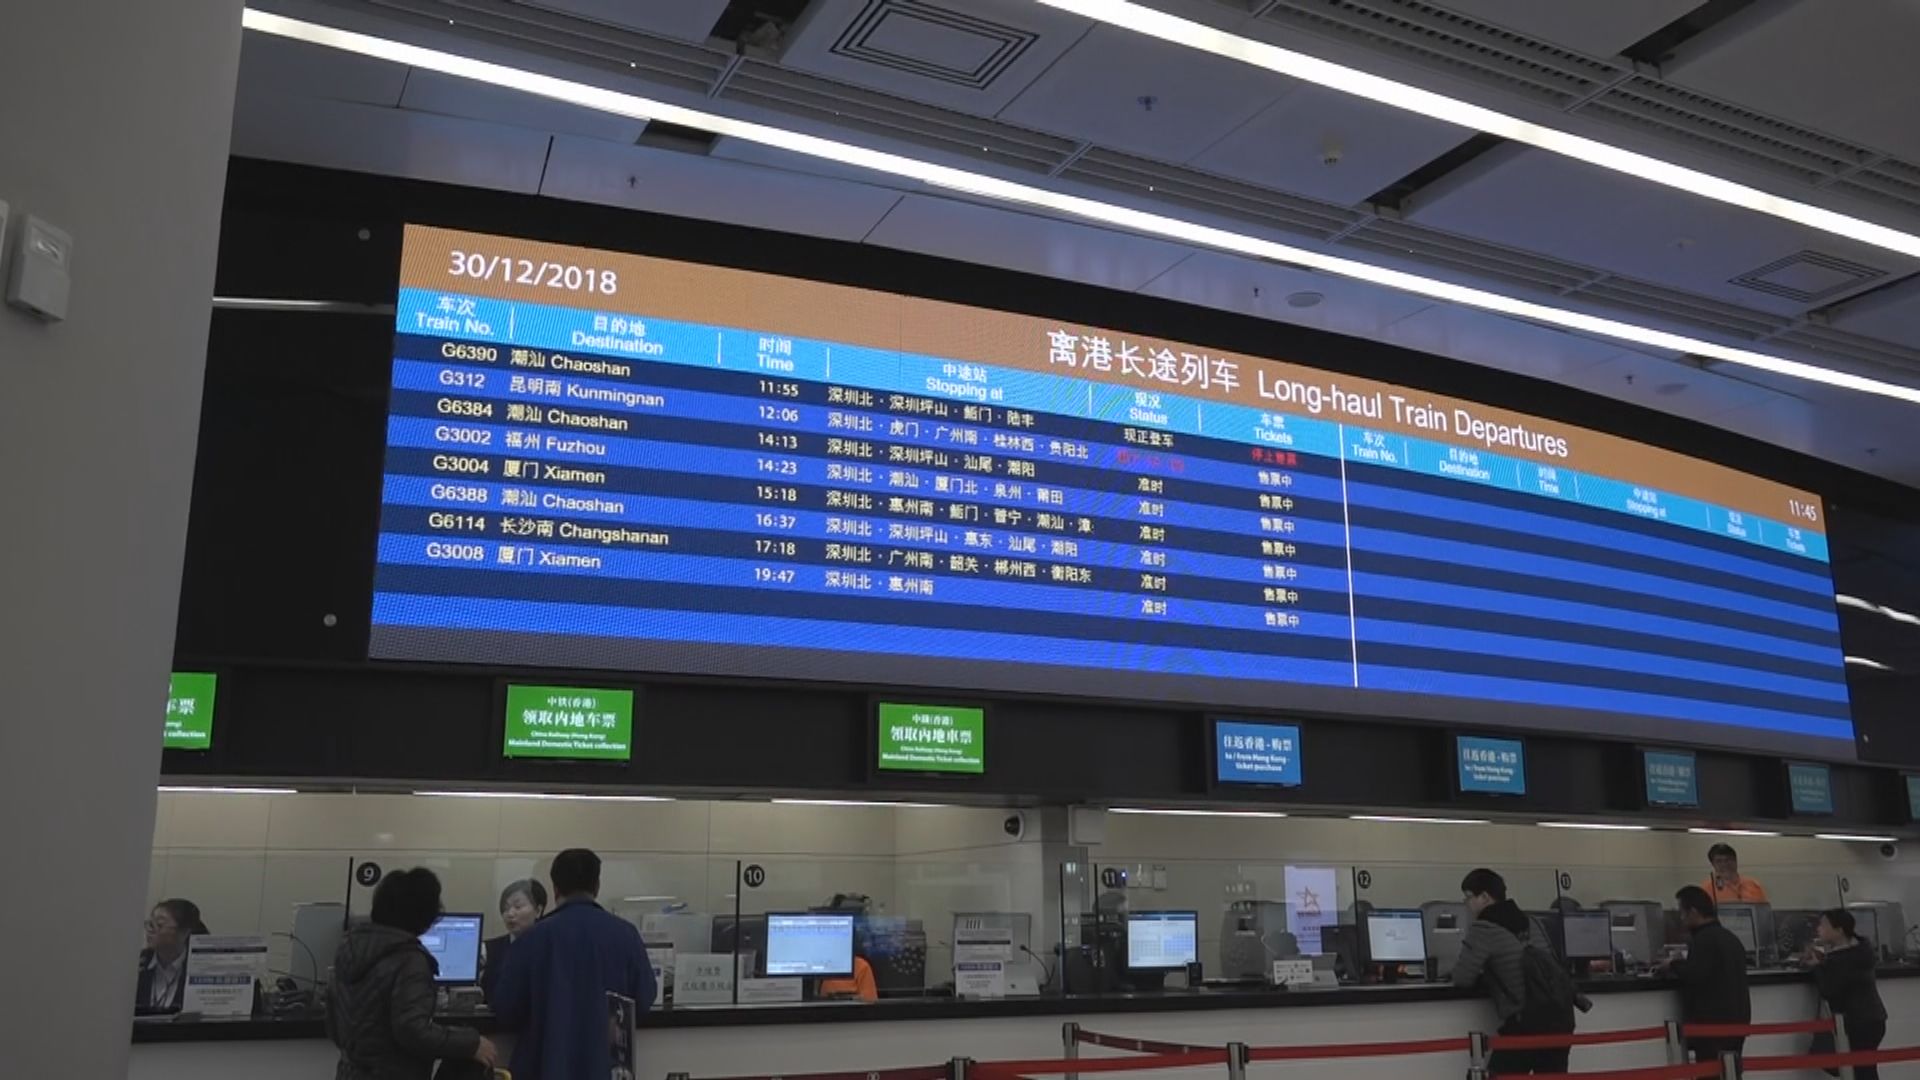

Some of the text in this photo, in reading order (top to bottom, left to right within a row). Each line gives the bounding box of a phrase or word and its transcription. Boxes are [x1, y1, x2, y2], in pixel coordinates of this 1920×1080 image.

[448, 250, 618, 294] 30/12/2018
[437, 296, 476, 317] 车次
[416, 312, 494, 337] Train No.
[594, 315, 646, 337] 目的地
[572, 331, 663, 356] Destination
[758, 337, 792, 356] 时间
[441, 342, 497, 362] G6390
[551, 353, 630, 377] Chaoshan
[757, 351, 794, 372] Time
[1047, 329, 1240, 393] 离港长途列车
[943, 363, 987, 384] 中途站
[440, 370, 664, 407] G312 昆明南 Kunmingnan
[760, 380, 799, 397] 11:55
[926, 376, 1003, 401] Stopping at
[828, 385, 873, 407] 深圳北
[889, 394, 948, 417] 深圳坪山
[437, 398, 492, 418] G6384
[547, 409, 628, 431] Chaoshan
[759, 406, 799, 423] 12:06
[1129, 407, 1168, 425] Status
[1258, 370, 1568, 458] Long-haul Train Departures
[828, 411, 873, 432] 深圳北
[889, 419, 919, 438] 虎门
[935, 425, 977, 446] 广州南
[1255, 426, 1293, 446] Tickets
[435, 426, 605, 456] G3002 福州 Fuzhou
[758, 432, 798, 450] 14:13
[827, 437, 873, 458] 深圳北
[889, 445, 948, 467] 深圳坪山
[964, 454, 993, 473] 汕尾
[1352, 444, 1398, 464] Train No.
[433, 455, 605, 484] G3004 厦门 Xiamen
[757, 458, 797, 475] 14:23
[1439, 460, 1491, 481] Destination
[827, 463, 873, 483] 深圳北
[935, 475, 978, 495] 厦门北
[1138, 476, 1163, 494] 准时
[431, 484, 488, 503] G6388
[543, 494, 624, 514] Chaoshan
[757, 485, 797, 502] 15:18
[826, 489, 873, 510] 深圳北
[888, 497, 934, 517] 惠州南
[1138, 500, 1164, 518] 准时
[1788, 498, 1818, 522] 11:45
[428, 512, 669, 546] G6114 长沙南 Changshanan
[755, 513, 796, 530] 16:37
[826, 517, 873, 537] 深圳北
[888, 523, 948, 544] 深圳坪山
[964, 531, 993, 548] 惠东
[1008, 535, 1037, 554] 汕尾
[1139, 525, 1165, 542] 准时
[426, 541, 601, 569] G3008 厦门 Xiamen
[755, 540, 796, 556] 17:18
[825, 543, 872, 563] 深圳北
[888, 550, 934, 569] 广州南
[1140, 549, 1166, 567] 准时
[754, 567, 795, 584] 19:47
[825, 570, 934, 596] 深圳北 惠州南
[1140, 574, 1167, 592] 准时
[1141, 599, 1168, 616] 准时
[523, 709, 617, 729] 领取内地车票
[508, 739, 627, 750] Mainland Domestic Ticket collection
[1252, 754, 1270, 764] Hong
[363, 866, 375, 883] 9
[747, 869, 763, 884] 10
